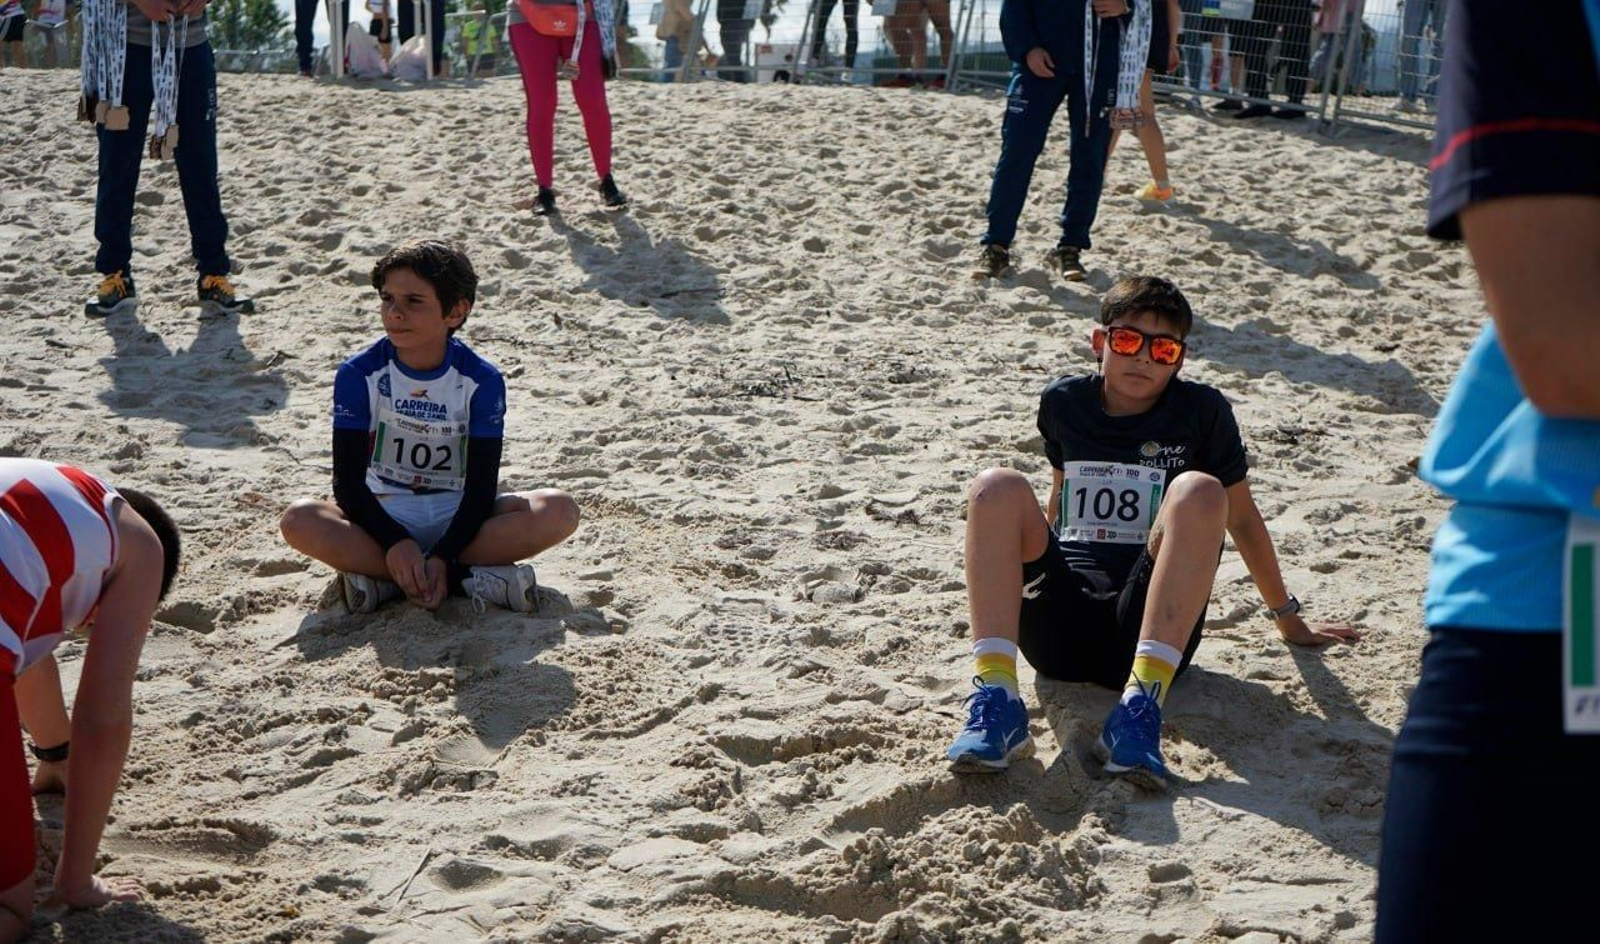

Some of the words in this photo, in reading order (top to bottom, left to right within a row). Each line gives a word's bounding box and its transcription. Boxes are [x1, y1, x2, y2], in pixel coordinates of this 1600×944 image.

[394, 399, 447, 414] CARREIRA
[393, 437, 452, 471] 102
[1076, 487, 1140, 522] 108
